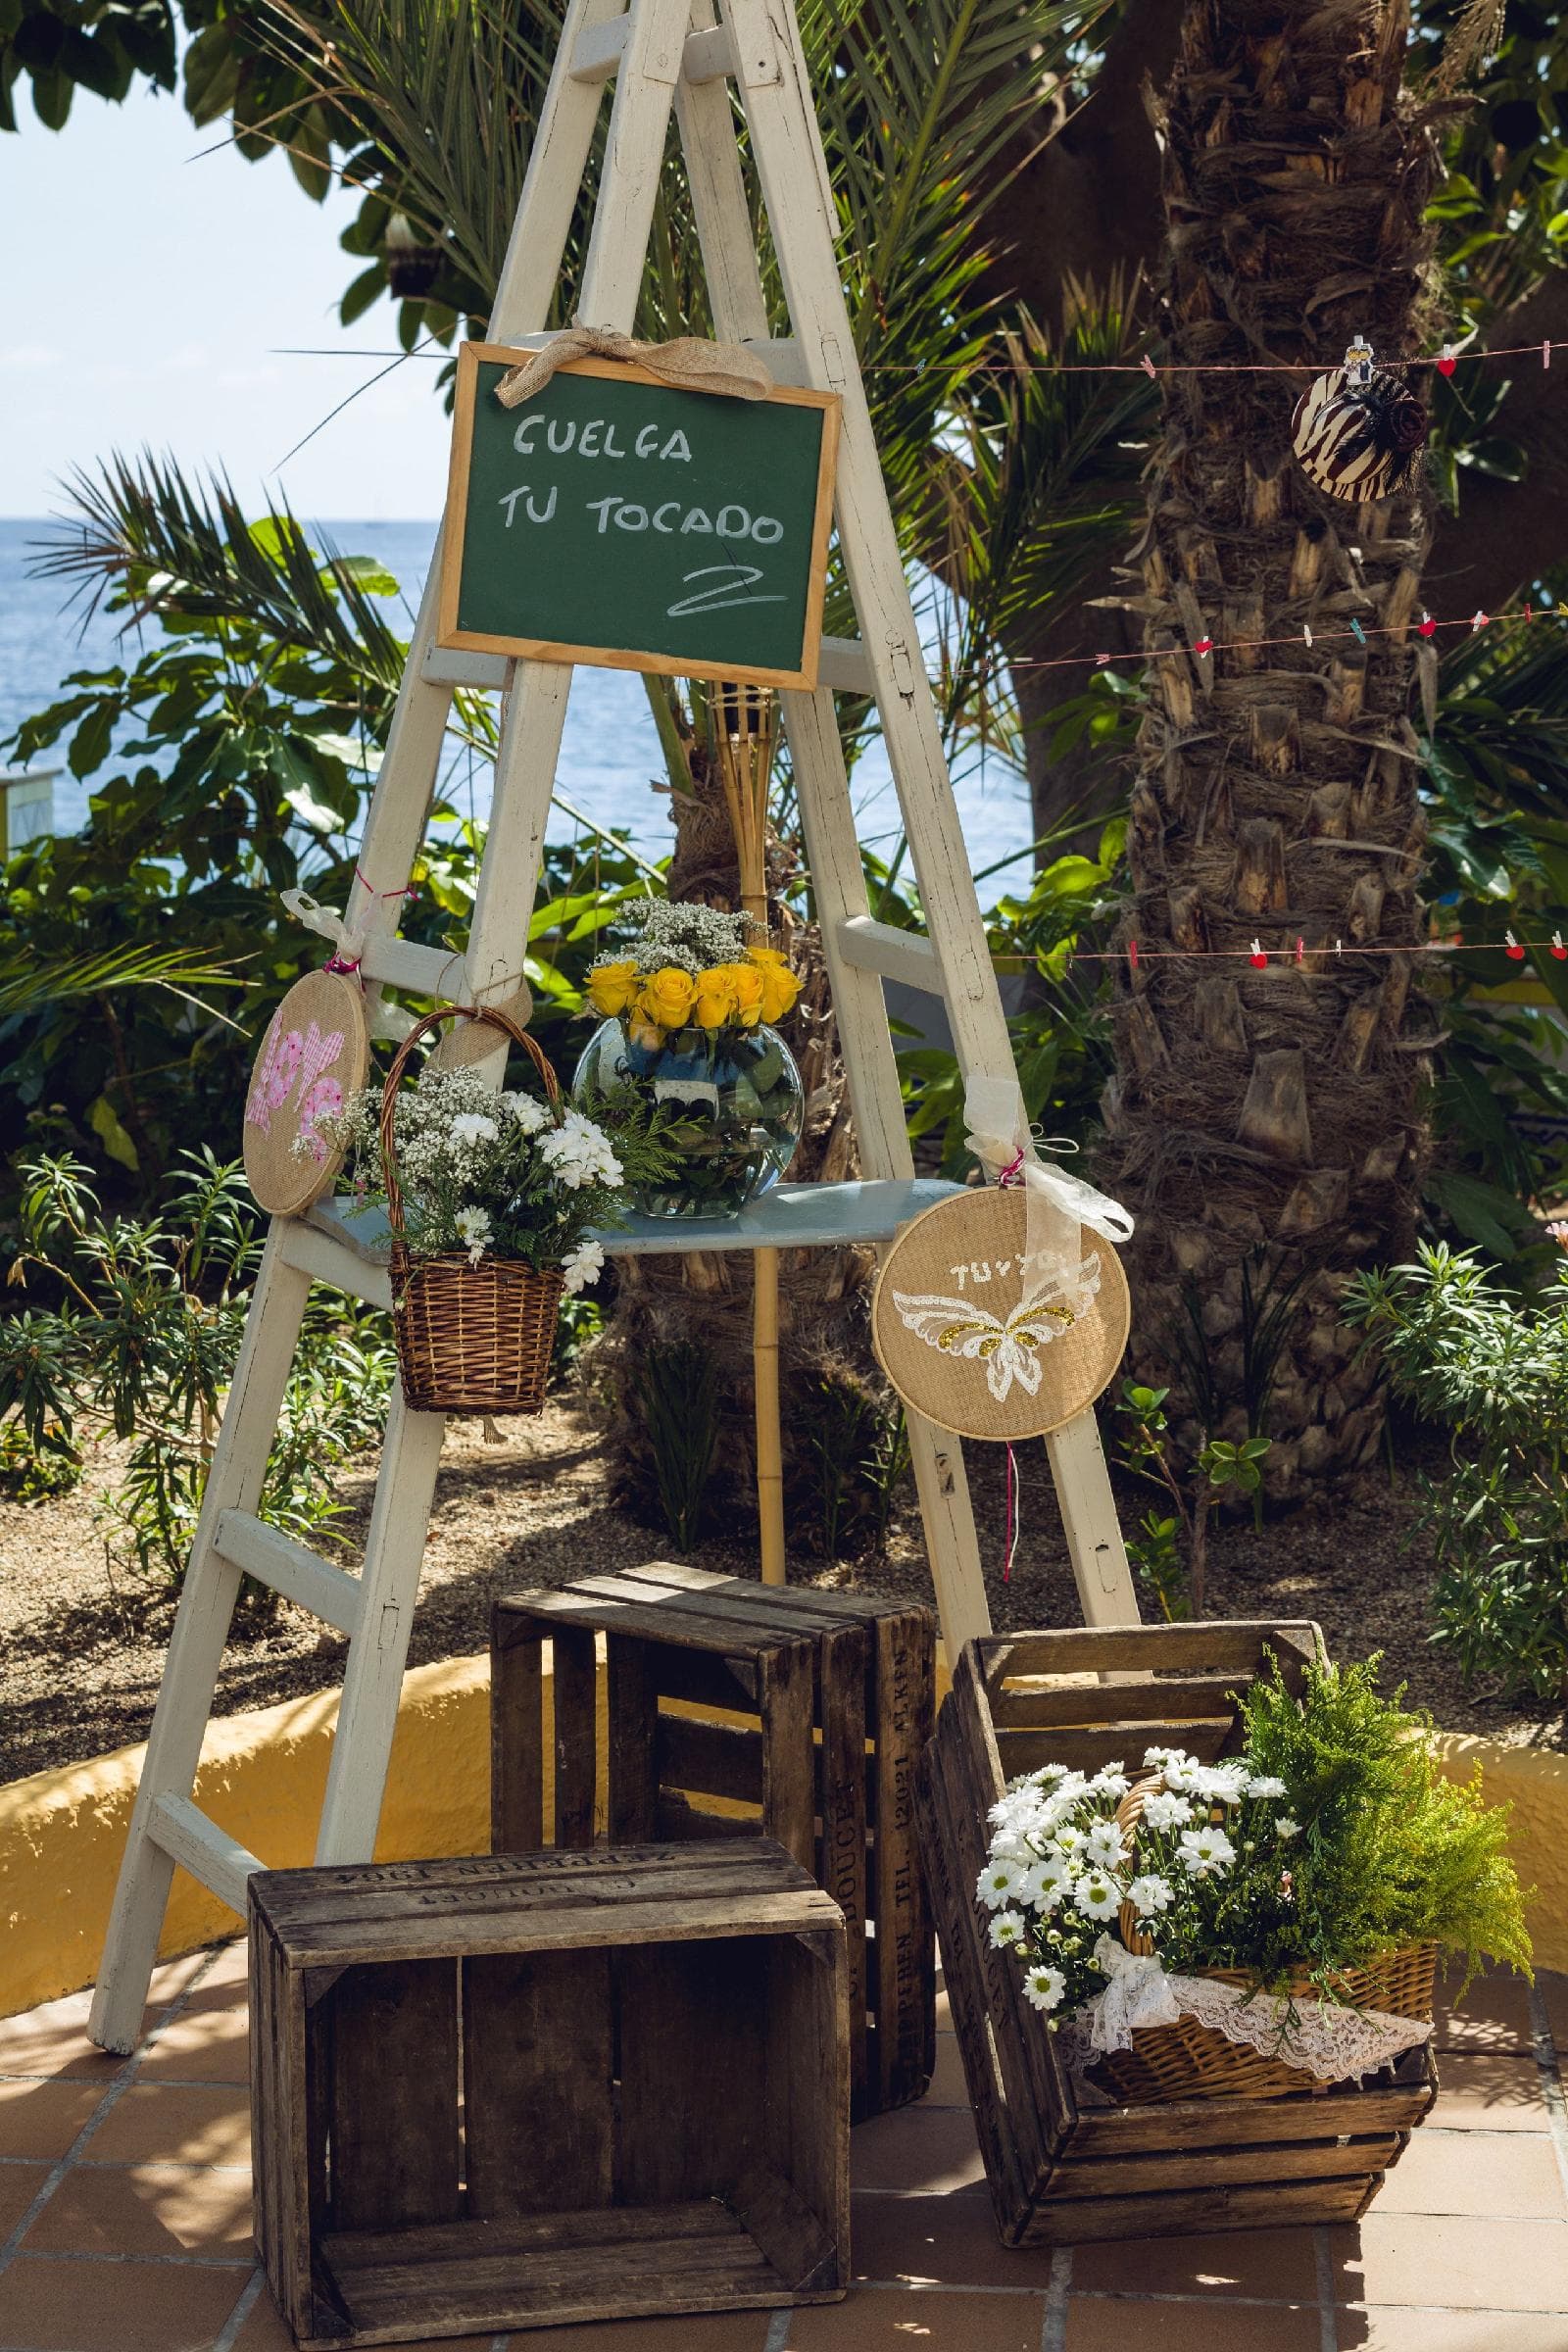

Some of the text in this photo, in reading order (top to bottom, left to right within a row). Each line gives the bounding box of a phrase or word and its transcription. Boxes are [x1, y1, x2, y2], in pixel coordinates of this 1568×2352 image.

[513, 414, 692, 463] CUELGA
[498, 486, 784, 544] TU TOCADO
[894, 1756, 910, 1831] 12021
